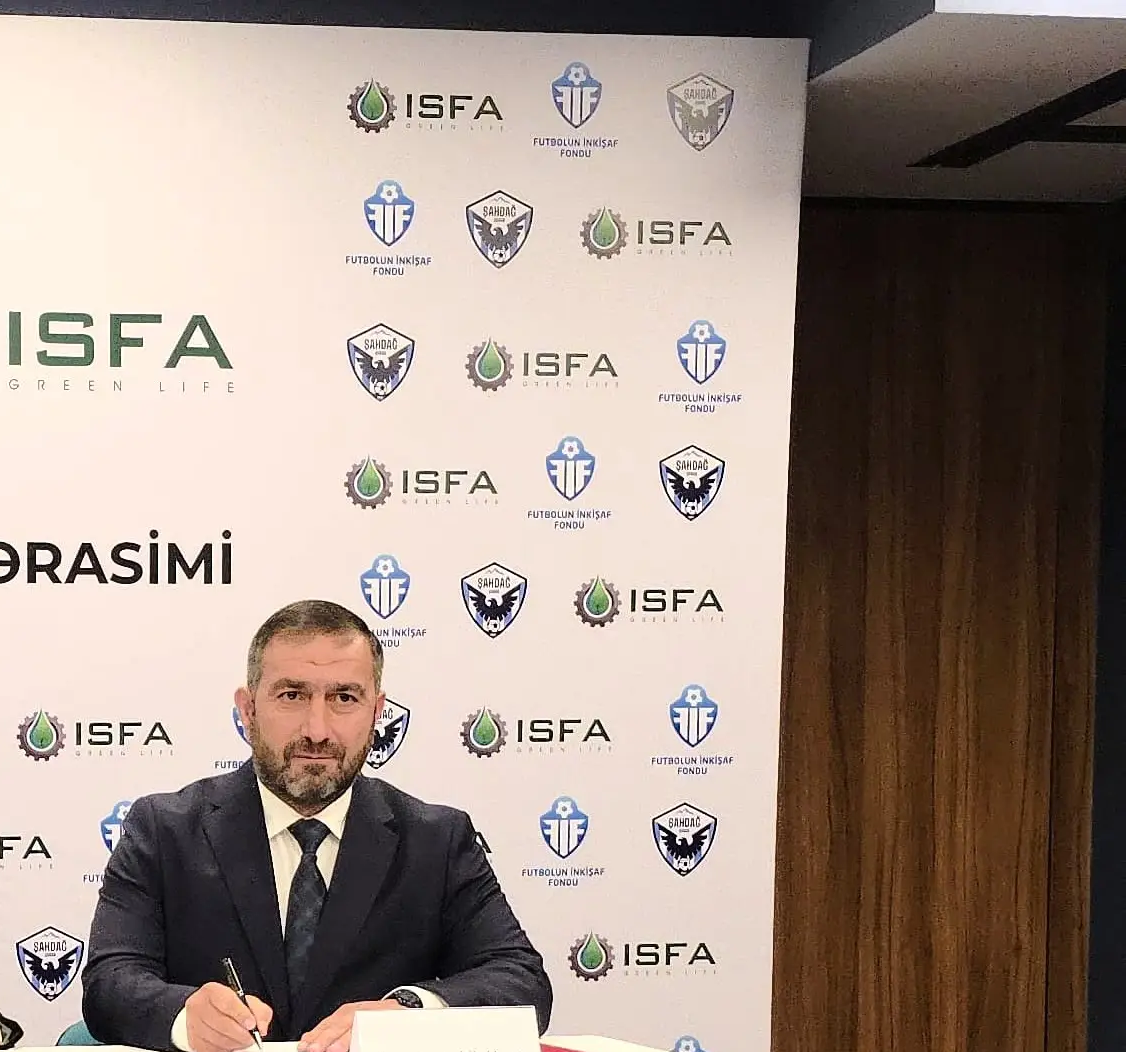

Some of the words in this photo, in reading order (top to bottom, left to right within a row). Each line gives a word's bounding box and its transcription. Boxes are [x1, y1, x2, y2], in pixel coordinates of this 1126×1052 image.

[407, 94, 503, 120] ISFA
[533, 137, 581, 147] FUTBOLUN
[560, 148, 592, 158] FONDU
[638, 221, 731, 245] ISFA
[345, 255, 394, 265] FUTBOLUN
[372, 266, 404, 276] FONDU
[9, 311, 233, 369] ISFA
[523, 353, 618, 377] ISFA
[8, 378, 122, 392] GREEN
[159, 381, 235, 394] LIFE
[658, 393, 705, 403] FUTBOLUN
[684, 404, 716, 413] FONDU
[403, 470, 497, 494] ISFA
[527, 510, 575, 519] FUTBOLUN
[554, 520, 585, 530] FONDU
[631, 590, 723, 612] ISFA
[76, 722, 172, 745] ISFA
[518, 719, 610, 742] ISFA
[651, 756, 698, 766] FUTBOLUN
[677, 766, 708, 775] FONDU
[521, 868, 568, 877] FUTBOLUN
[548, 878, 579, 887] FONDU
[624, 943, 715, 966] ISFA
